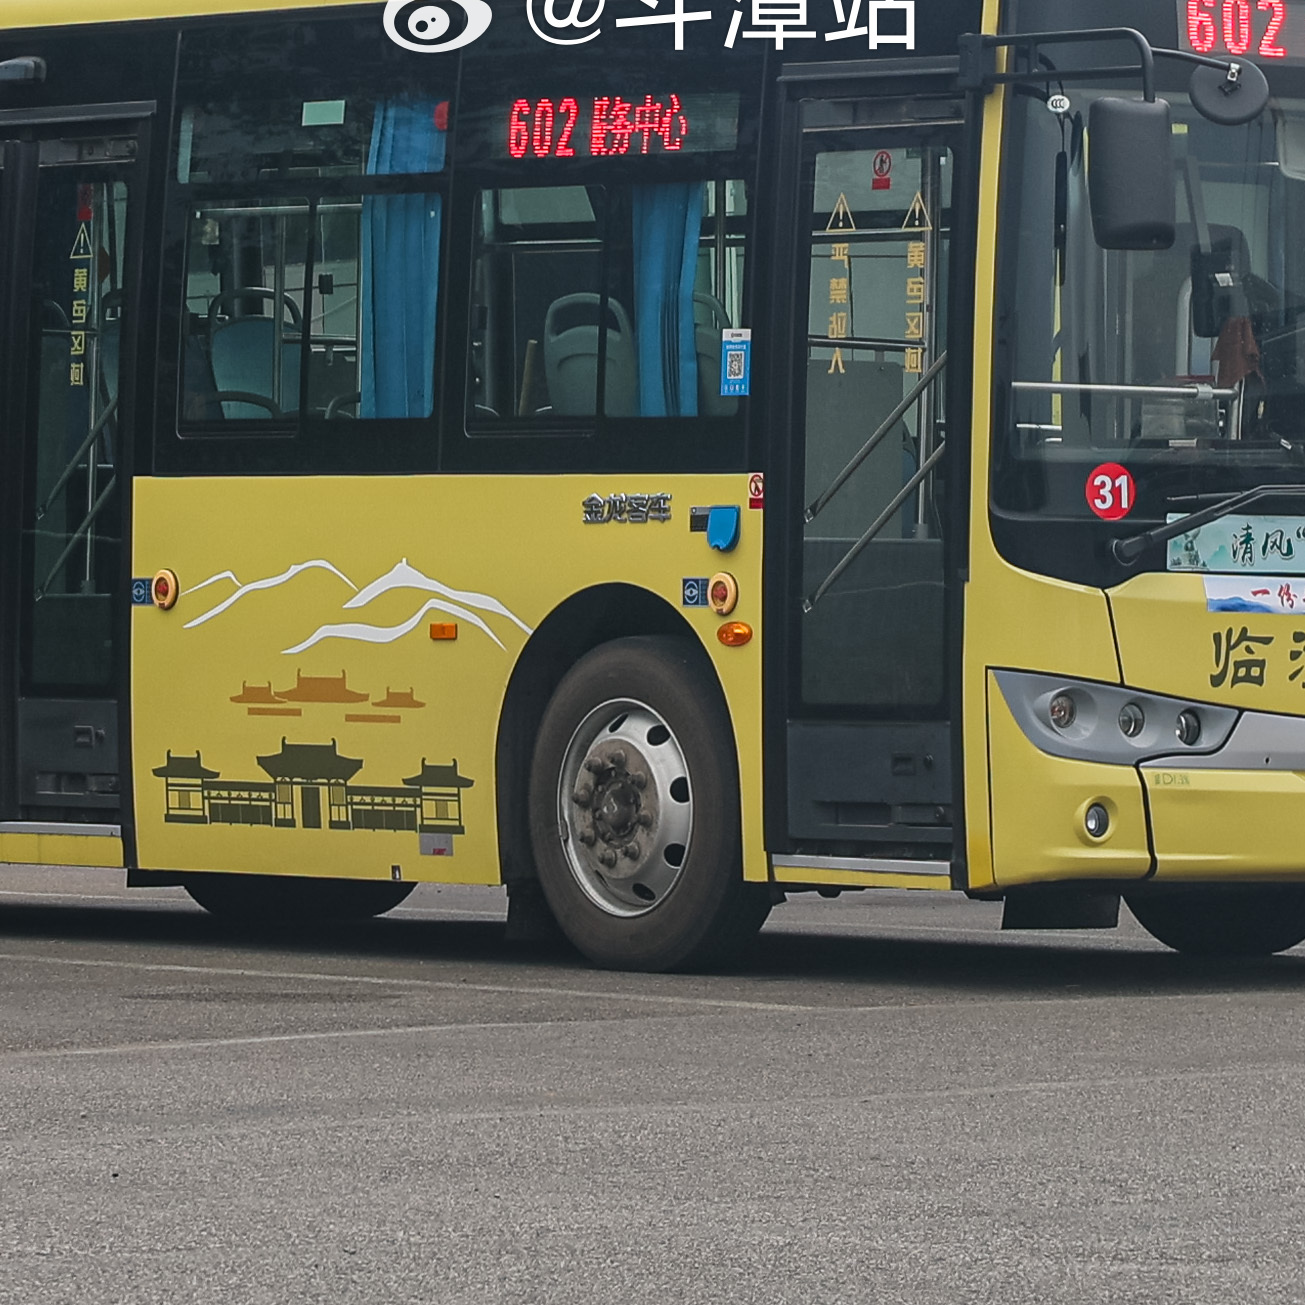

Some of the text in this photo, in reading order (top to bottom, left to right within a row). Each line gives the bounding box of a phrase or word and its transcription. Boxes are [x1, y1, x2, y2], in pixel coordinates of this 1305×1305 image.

[510, 98, 579, 158] 602
[582, 492, 672, 525] 金龙客车
[1093, 474, 1132, 511] 31
